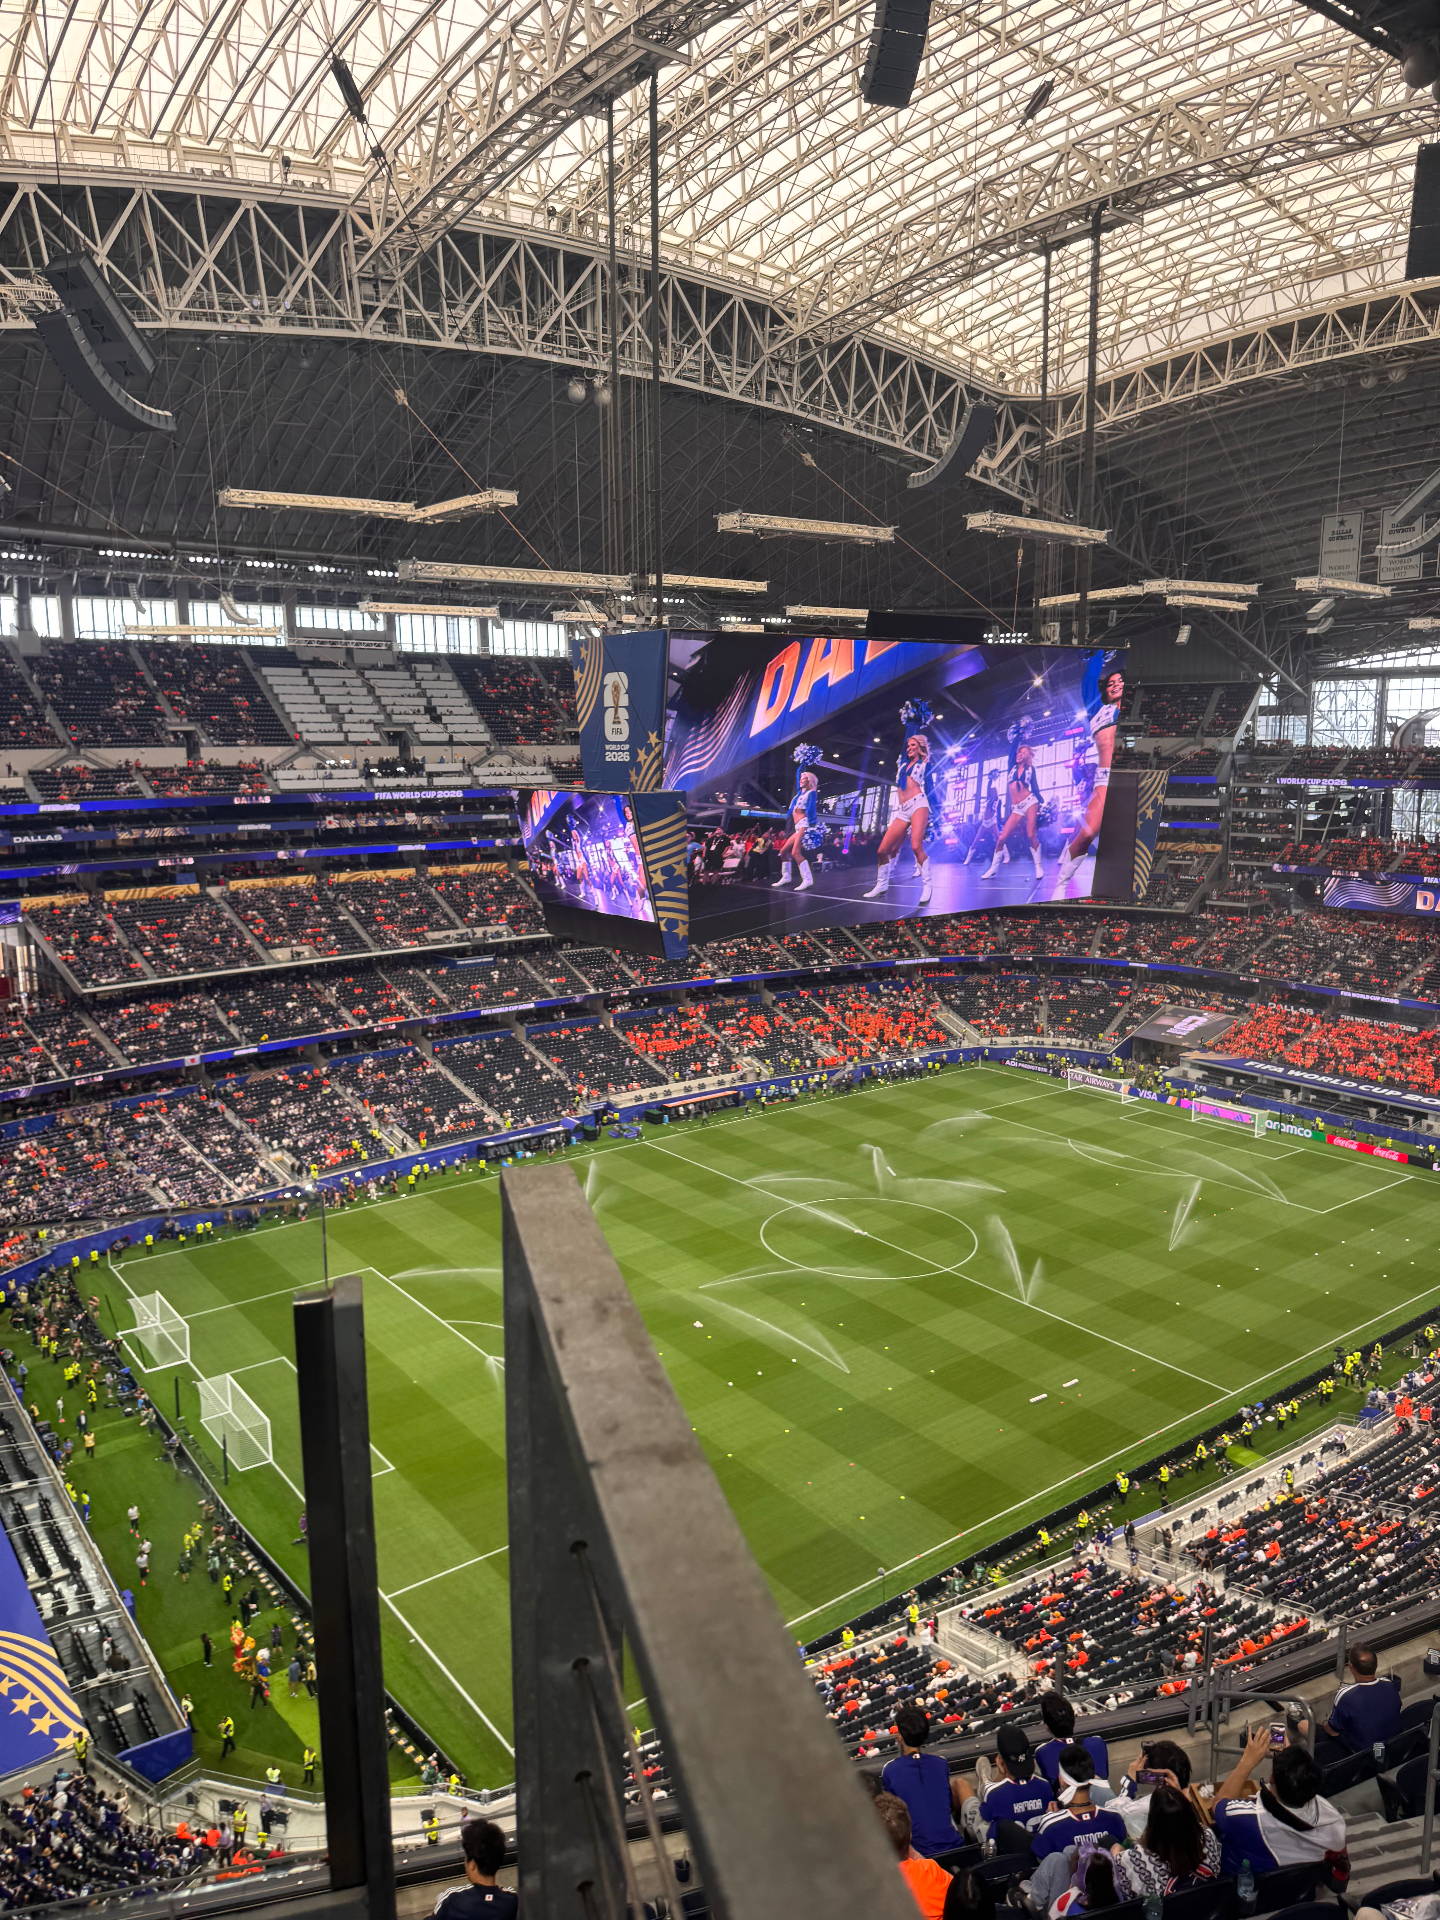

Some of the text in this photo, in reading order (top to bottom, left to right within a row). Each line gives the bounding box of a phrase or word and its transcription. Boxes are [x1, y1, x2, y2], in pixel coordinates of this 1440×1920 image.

[605, 752, 630, 762] 2026
[233, 796, 271, 804] DALLAS
[374, 790, 463, 800] FIFA WORLD CUP 2026
[13, 834, 63, 844] DALLAS
[158, 857, 194, 867] DALLAS
[1332, 869, 1359, 878] DALLAS
[1084, 1076, 1115, 1090] AIRWAYS
[1243, 1061, 1285, 1073] FIFA
[1287, 1069, 1358, 1087] WORLD
[1359, 1084, 1402, 1096] CUP
[1138, 1089, 1158, 1101] VISA
[1265, 1120, 1312, 1138] aramco
[1013, 1798, 1043, 1814] KAMADA
